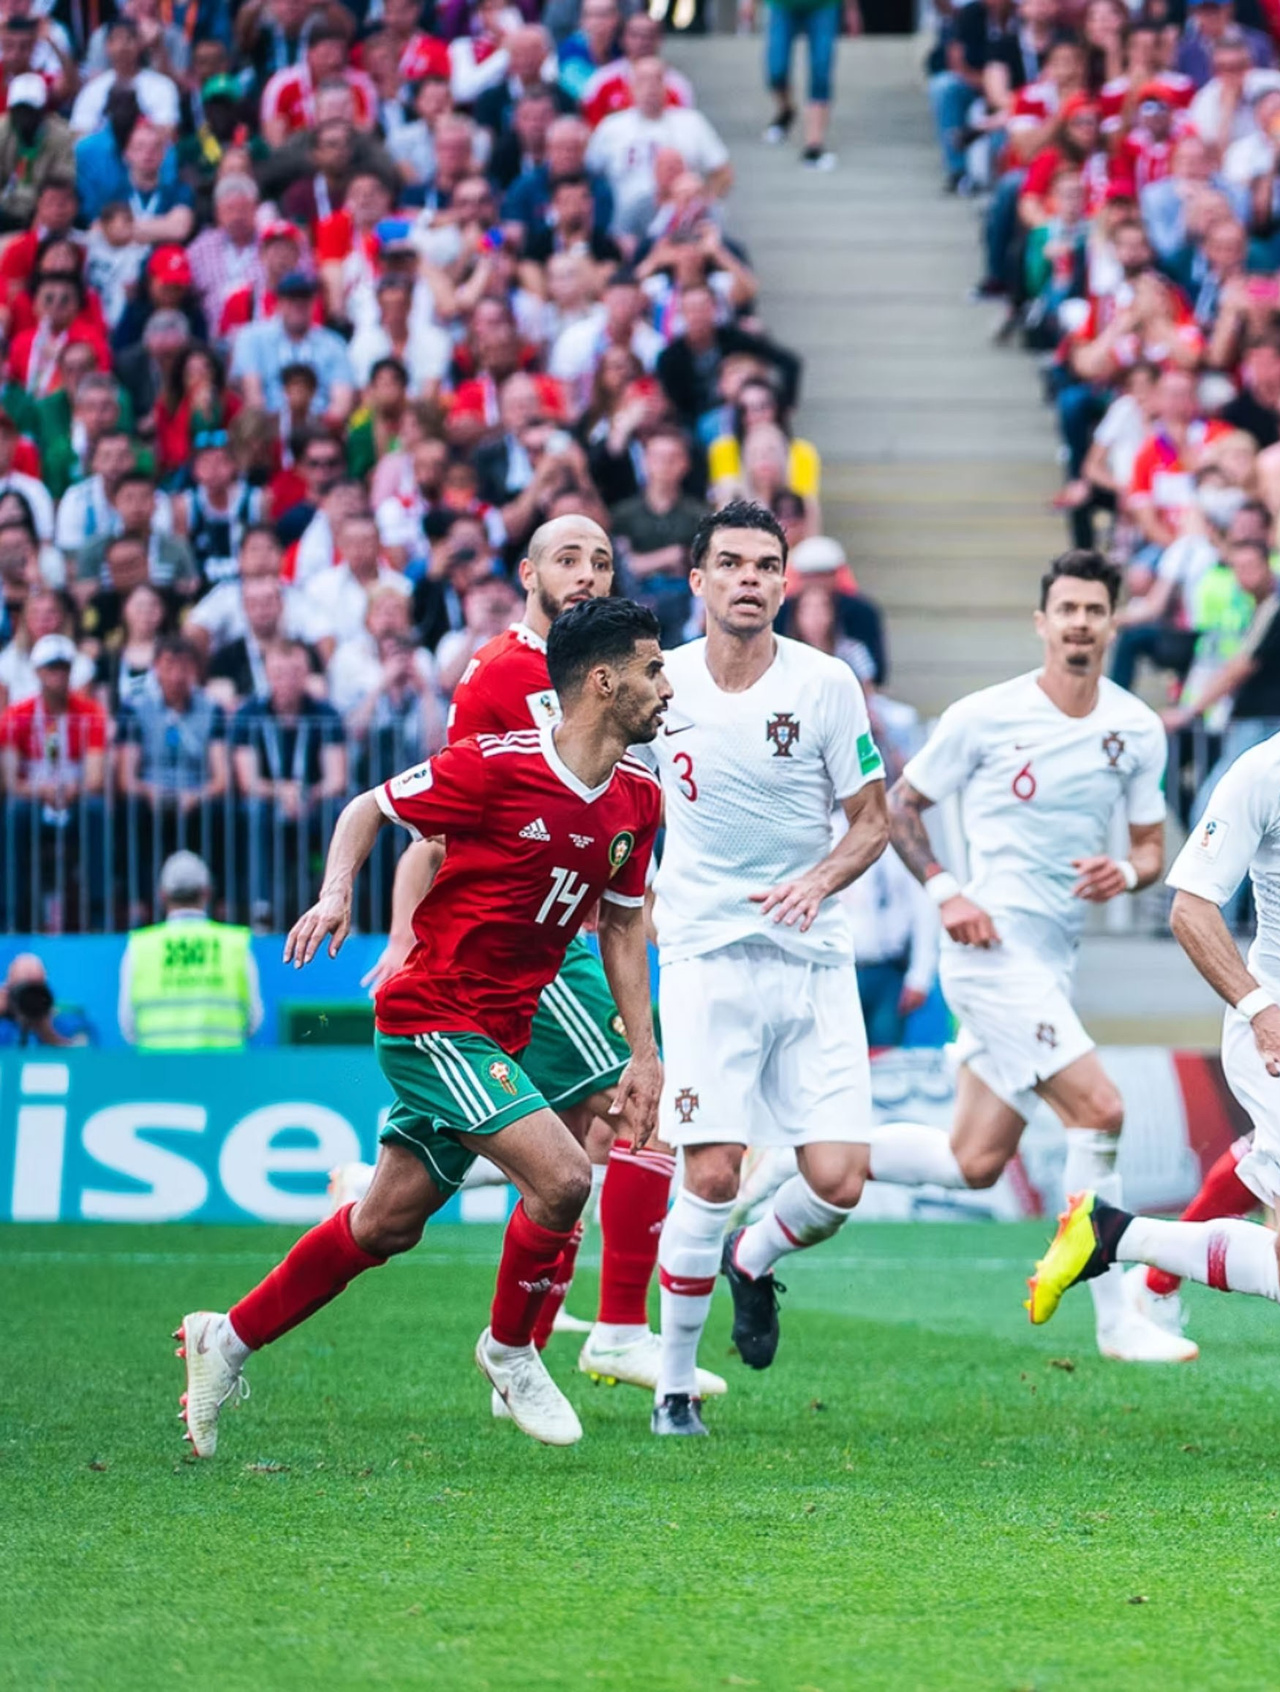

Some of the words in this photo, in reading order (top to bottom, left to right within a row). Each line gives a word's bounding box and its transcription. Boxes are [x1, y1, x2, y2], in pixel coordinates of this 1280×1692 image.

[673, 751, 698, 803] 3
[1012, 760, 1036, 802] 6
[535, 866, 590, 928] 14
